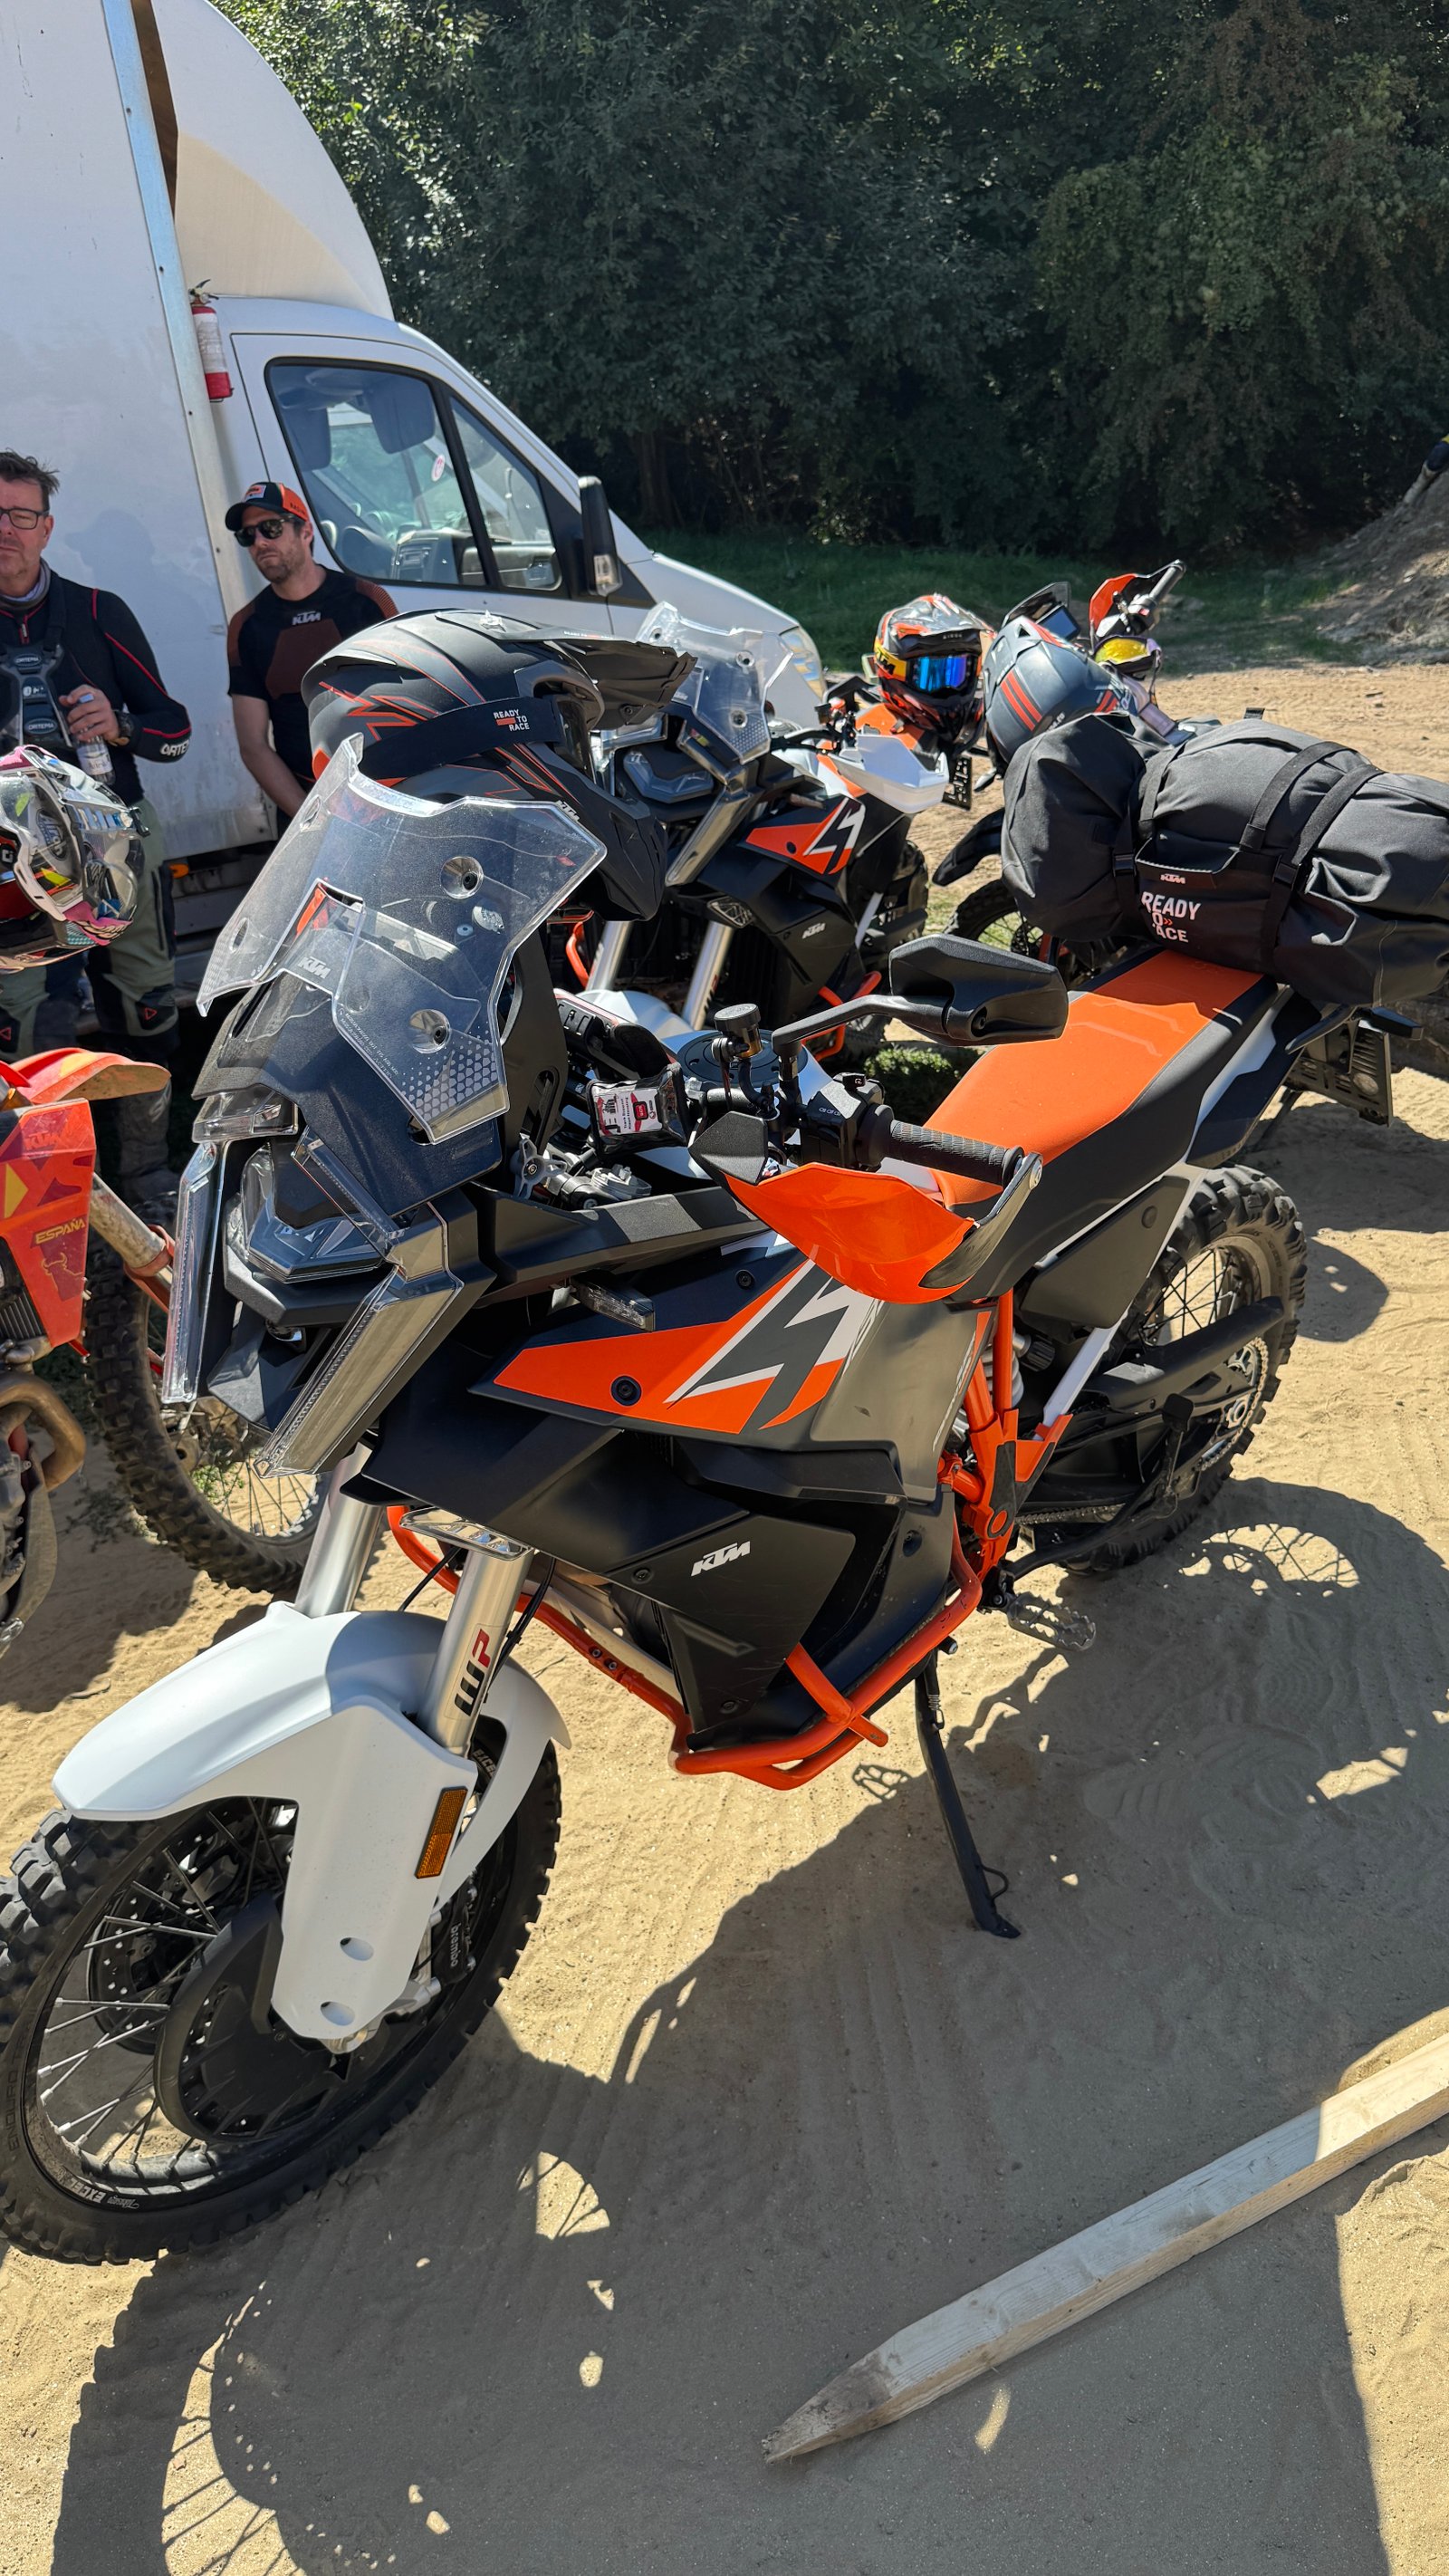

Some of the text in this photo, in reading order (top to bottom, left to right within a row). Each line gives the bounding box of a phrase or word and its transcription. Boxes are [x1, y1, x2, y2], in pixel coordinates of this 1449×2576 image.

[292, 610, 321, 626] KTM
[493, 709, 520, 719] READY
[516, 716, 528, 724] TO
[508, 723, 531, 732] RACE
[1160, 873, 1186, 884] KTM
[1141, 891, 1202, 920] READY
[801, 922, 826, 939] KTM
[1152, 923, 1189, 943] ACE
[297, 956, 331, 979] KTM
[35, 1218, 86, 1245] ESPAÑA
[691, 1541, 751, 1577] KTM
[454, 1628, 491, 1717] WP
[450, 1922, 462, 1967] brembo
[5, 2069, 20, 2152] ENDURO
[70, 2177, 107, 2204] EXCEL
